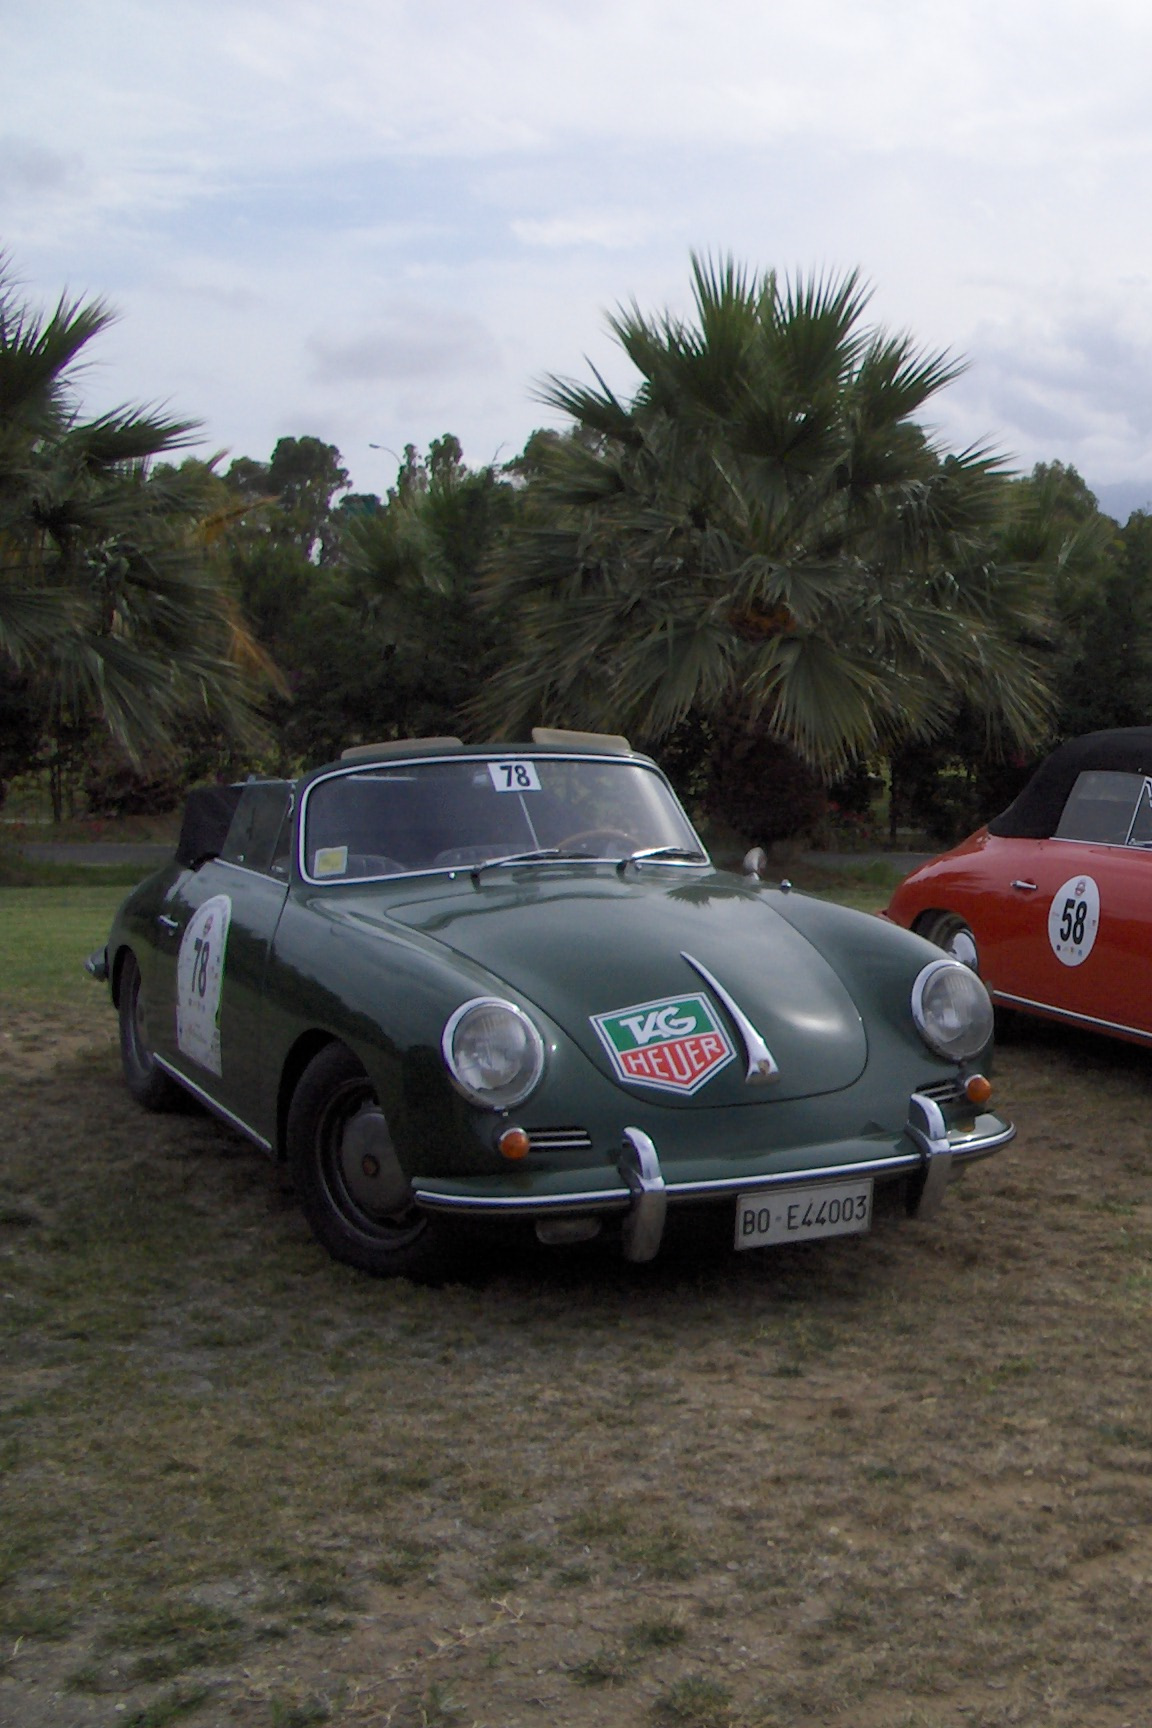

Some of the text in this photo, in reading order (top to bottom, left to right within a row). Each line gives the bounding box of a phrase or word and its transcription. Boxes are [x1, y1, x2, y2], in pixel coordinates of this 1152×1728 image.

[499, 764, 531, 788] 78
[1060, 898, 1088, 946] 58
[191, 937, 210, 998] 78
[619, 1006, 697, 1045] TAG
[627, 1037, 721, 1081] HEUER
[742, 1194, 868, 1236] BO E44003
